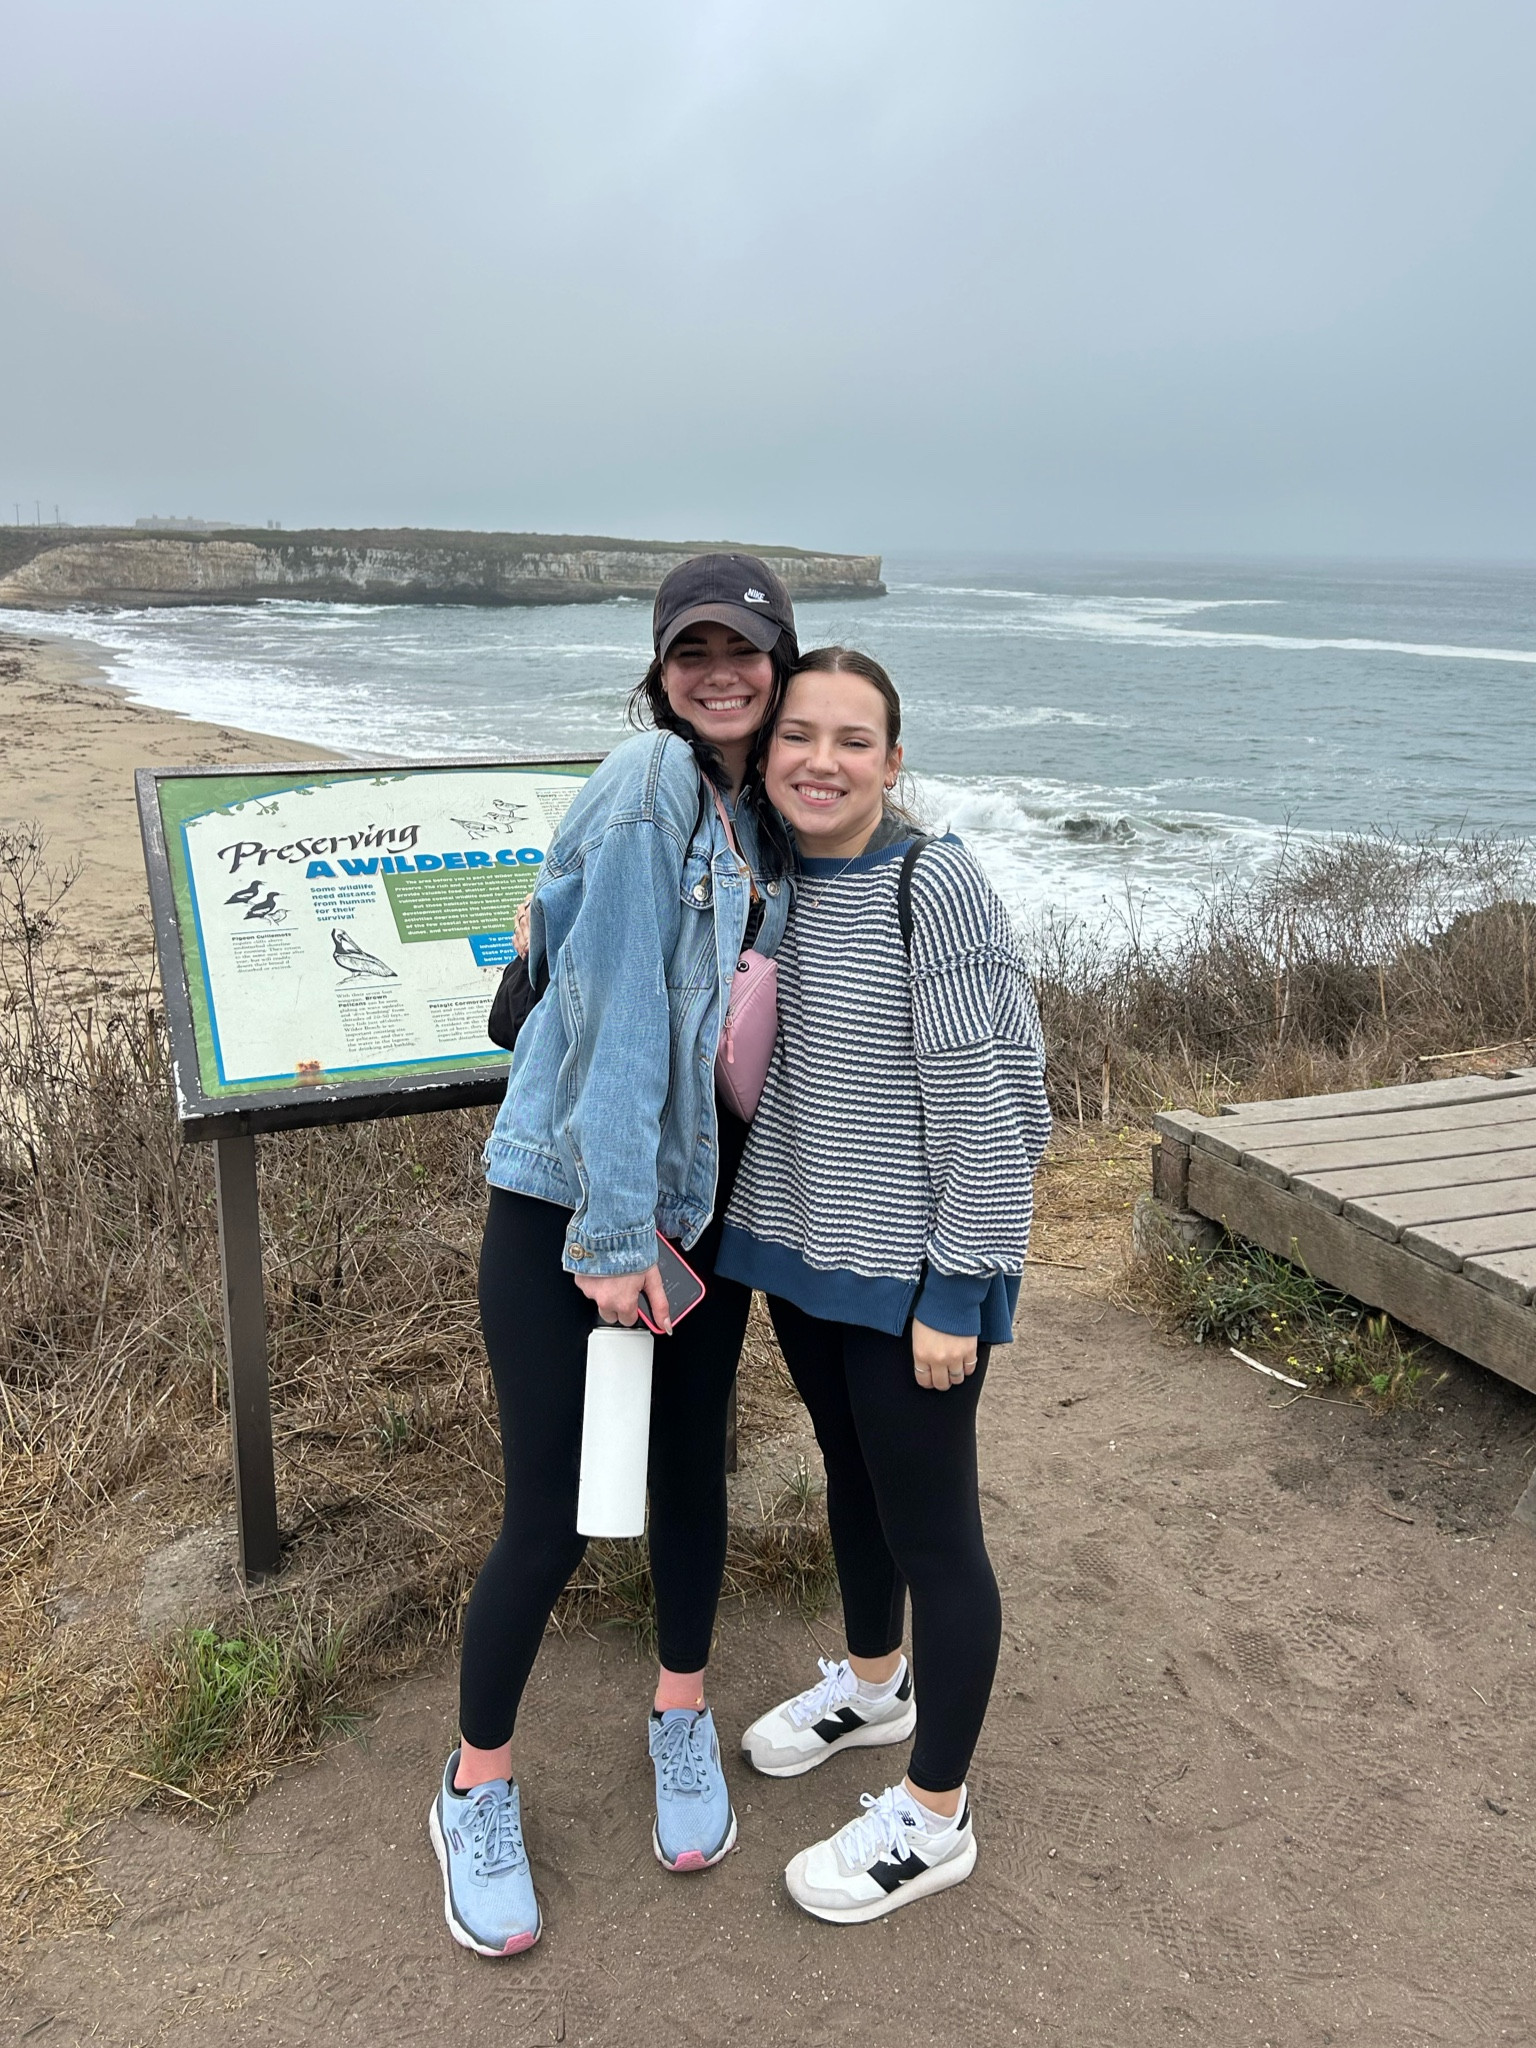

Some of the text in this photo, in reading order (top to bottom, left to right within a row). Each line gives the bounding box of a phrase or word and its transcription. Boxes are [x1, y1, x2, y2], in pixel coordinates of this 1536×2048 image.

[748, 588, 765, 600] NIKE
[217, 823, 421, 874] Preserving
[306, 847, 545, 878] A WILDER CO
[338, 883, 374, 891] wildlife
[337, 890, 377, 898] distance
